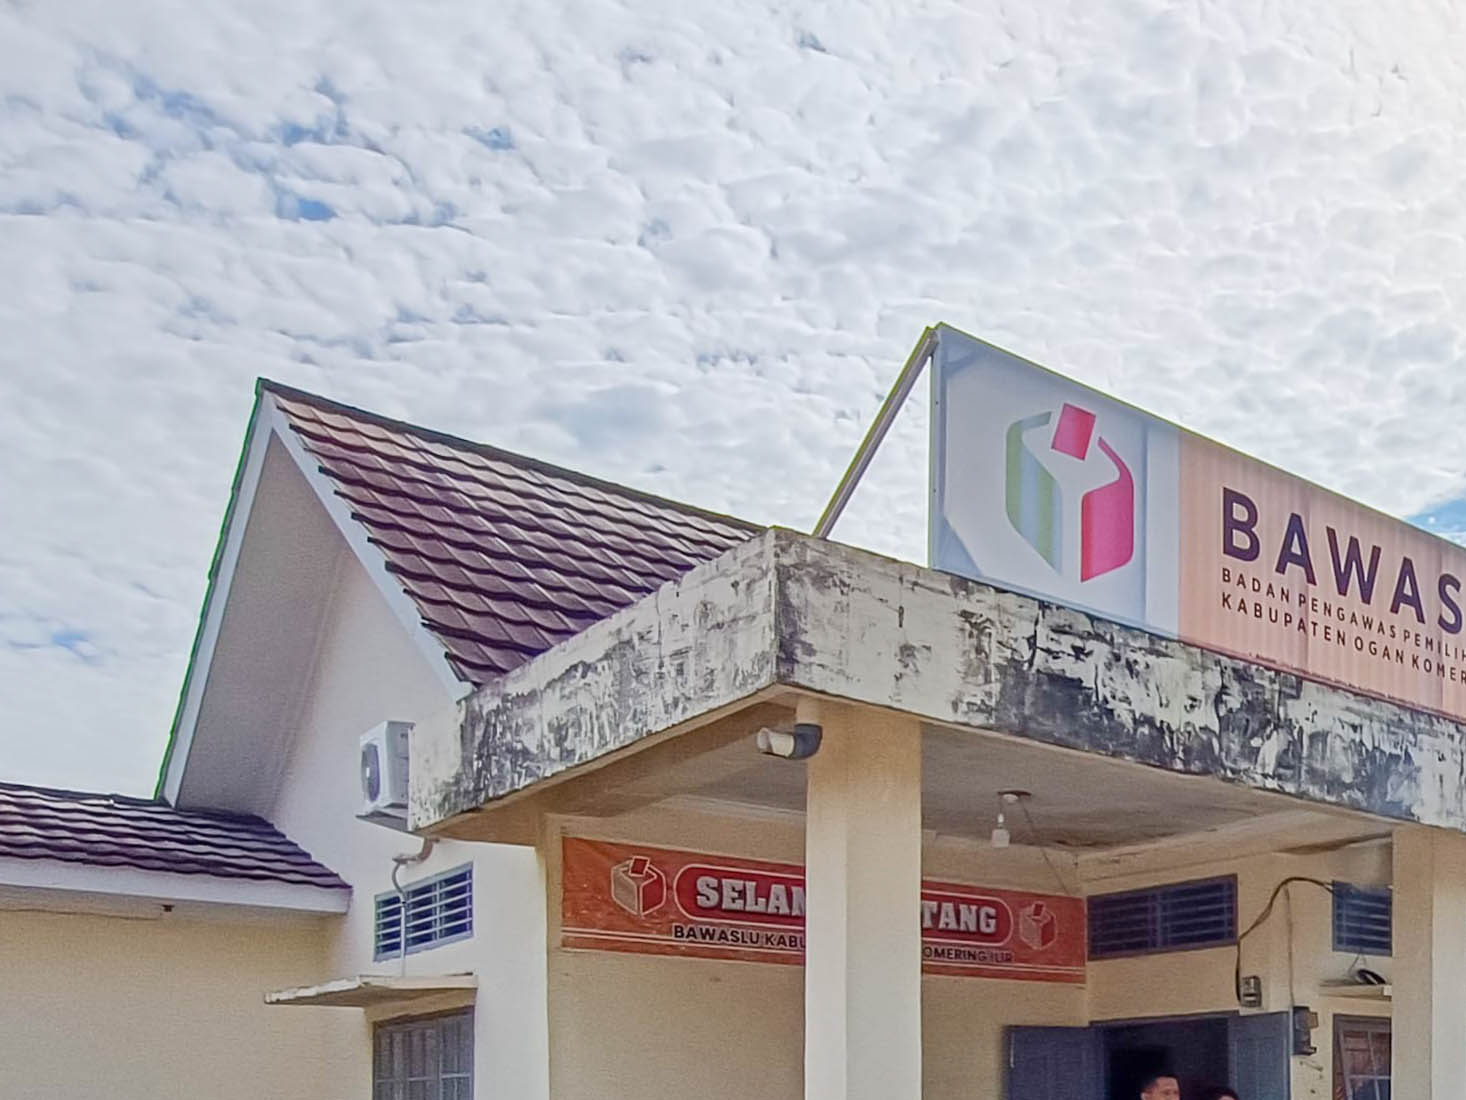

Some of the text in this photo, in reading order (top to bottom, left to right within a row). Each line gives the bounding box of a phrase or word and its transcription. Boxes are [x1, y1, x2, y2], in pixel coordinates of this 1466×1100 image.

[1222, 567, 1290, 603] BADAN
[1298, 593, 1396, 639] PENGAWAS
[1222, 592, 1346, 647] KABUPATEN
[1354, 636, 1404, 665] OGAN
[696, 875, 997, 934] SELA TANG
[673, 925, 760, 945] BAWASLU
[922, 946, 987, 961] OMERING
